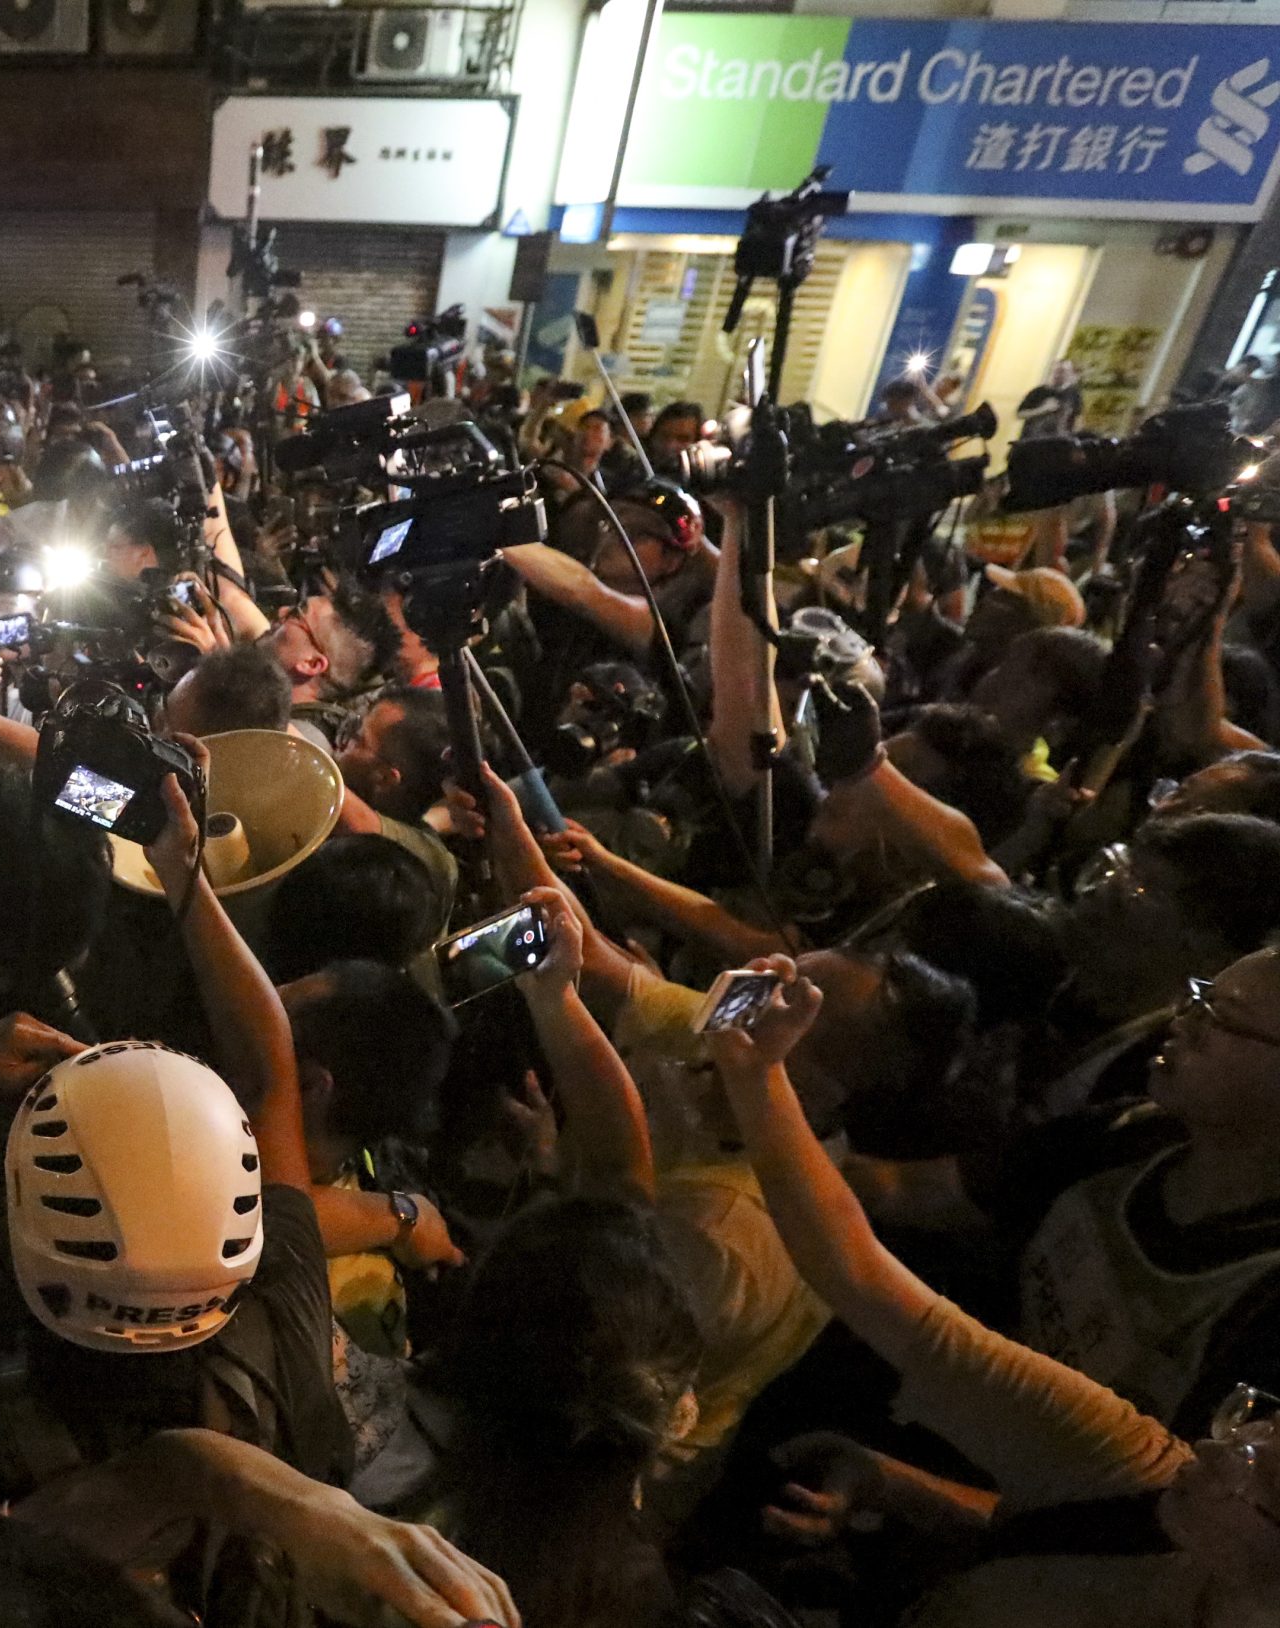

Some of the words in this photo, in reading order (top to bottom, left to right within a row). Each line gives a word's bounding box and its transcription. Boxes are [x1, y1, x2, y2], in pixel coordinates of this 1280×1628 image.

[658, 43, 912, 103] Standard
[917, 47, 1199, 108] Chartered
[964, 121, 1169, 175] 渣打銀行
[86, 1292, 226, 1324] PRESS
